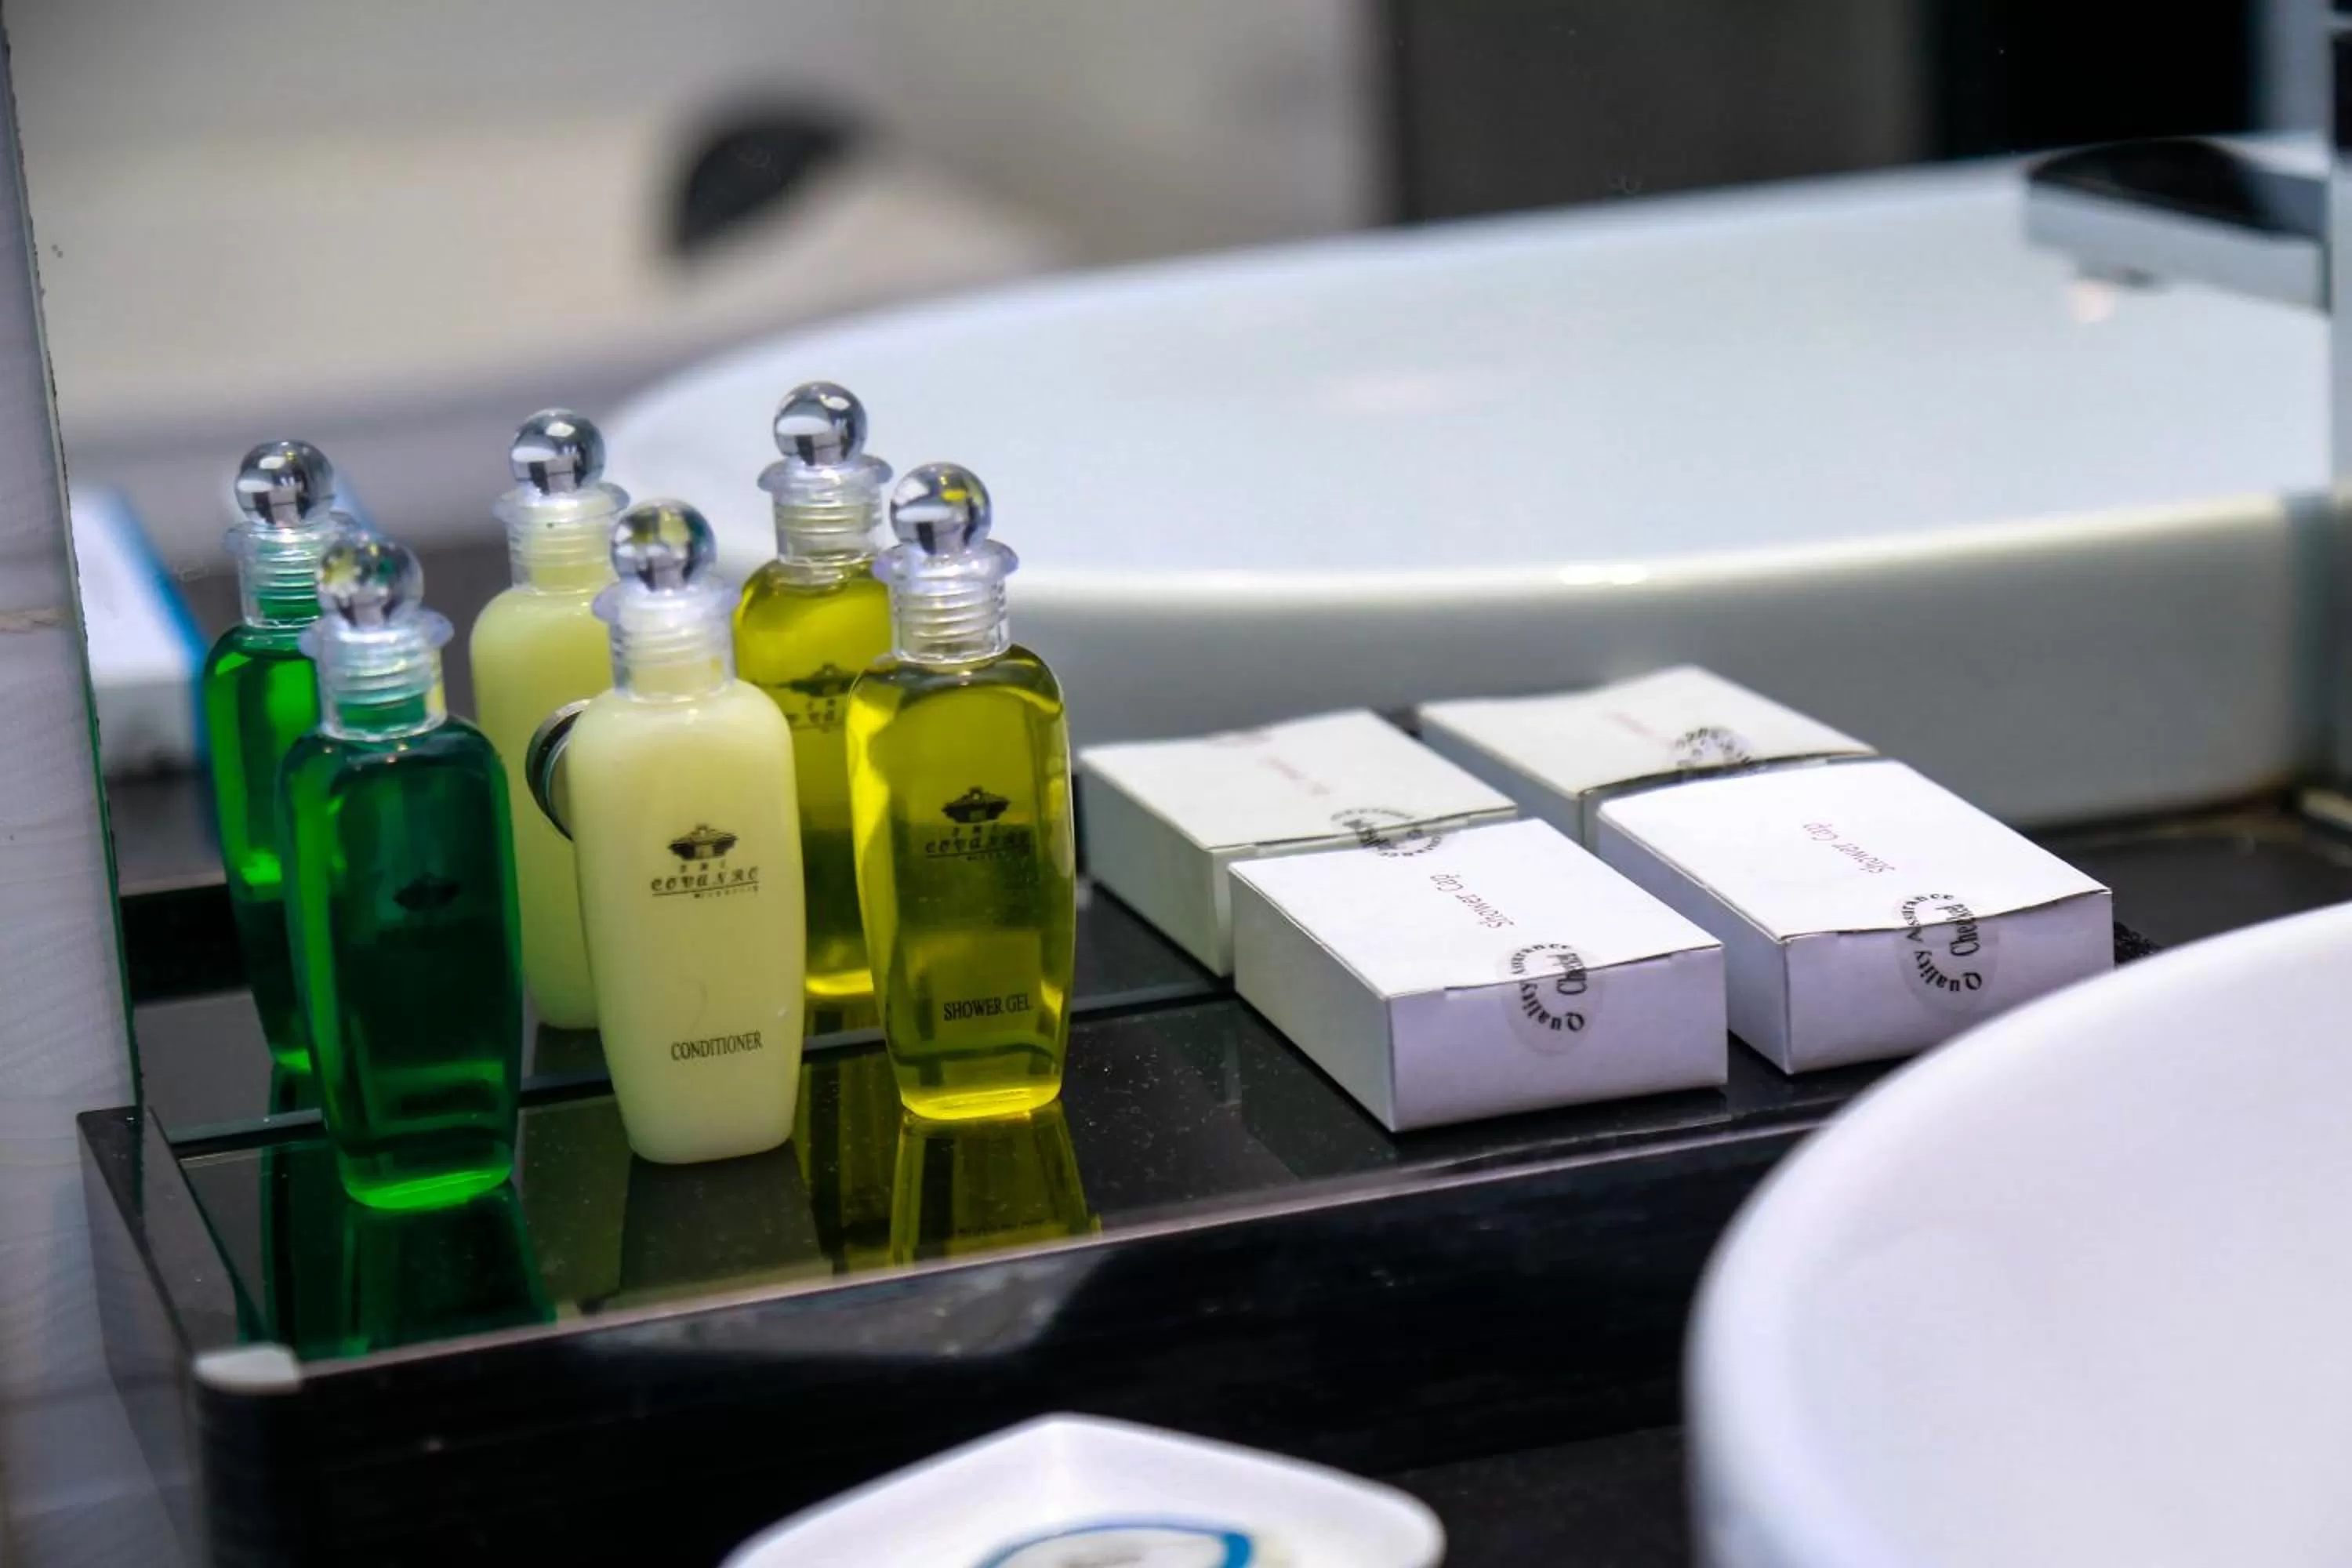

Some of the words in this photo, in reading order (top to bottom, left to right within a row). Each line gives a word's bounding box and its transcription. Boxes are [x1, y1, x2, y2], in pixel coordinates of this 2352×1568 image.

[1914, 951, 1982, 992] Quality
[943, 996, 1004, 1021] SHOWER
[1006, 993, 1030, 1013] GEL
[1521, 982, 1584, 1031] Quality
[671, 1029, 764, 1061] CONDITIONER
